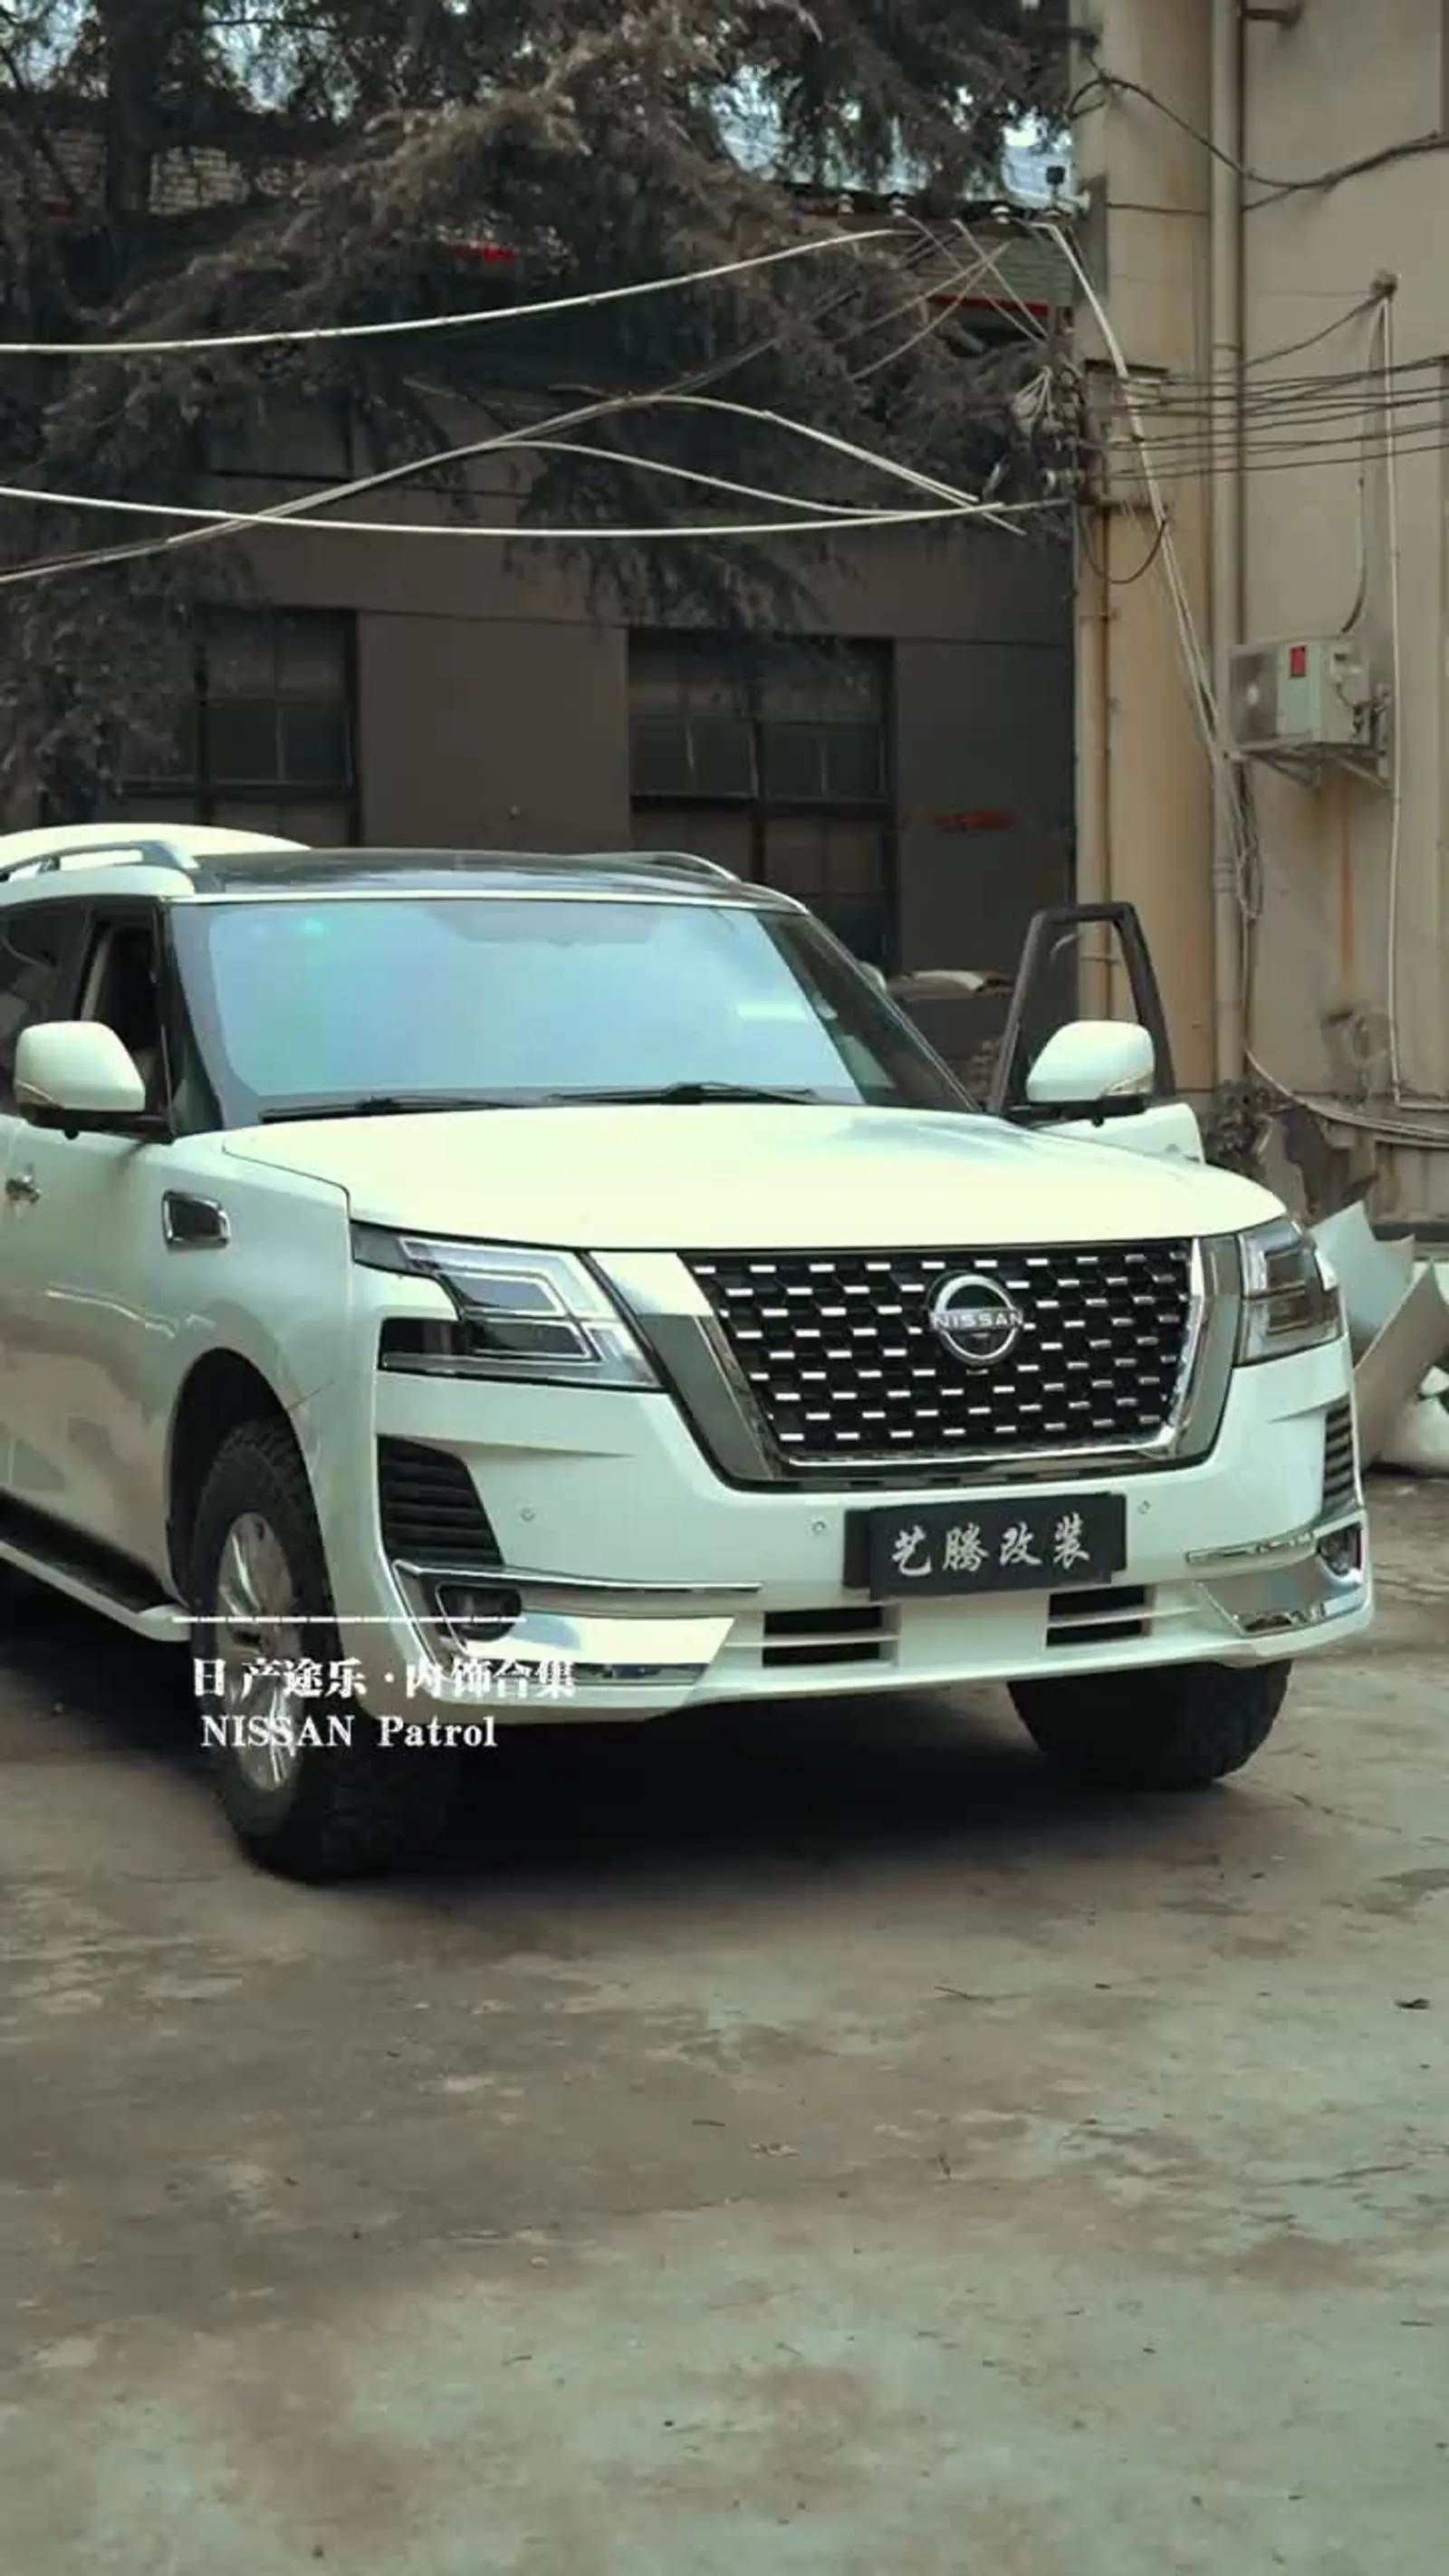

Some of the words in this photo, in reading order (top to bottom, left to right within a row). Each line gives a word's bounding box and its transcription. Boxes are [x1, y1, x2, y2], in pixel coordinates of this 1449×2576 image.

[931, 1310, 1024, 1329] NISSAN
[891, 1512, 1089, 1576] 艺腾改装
